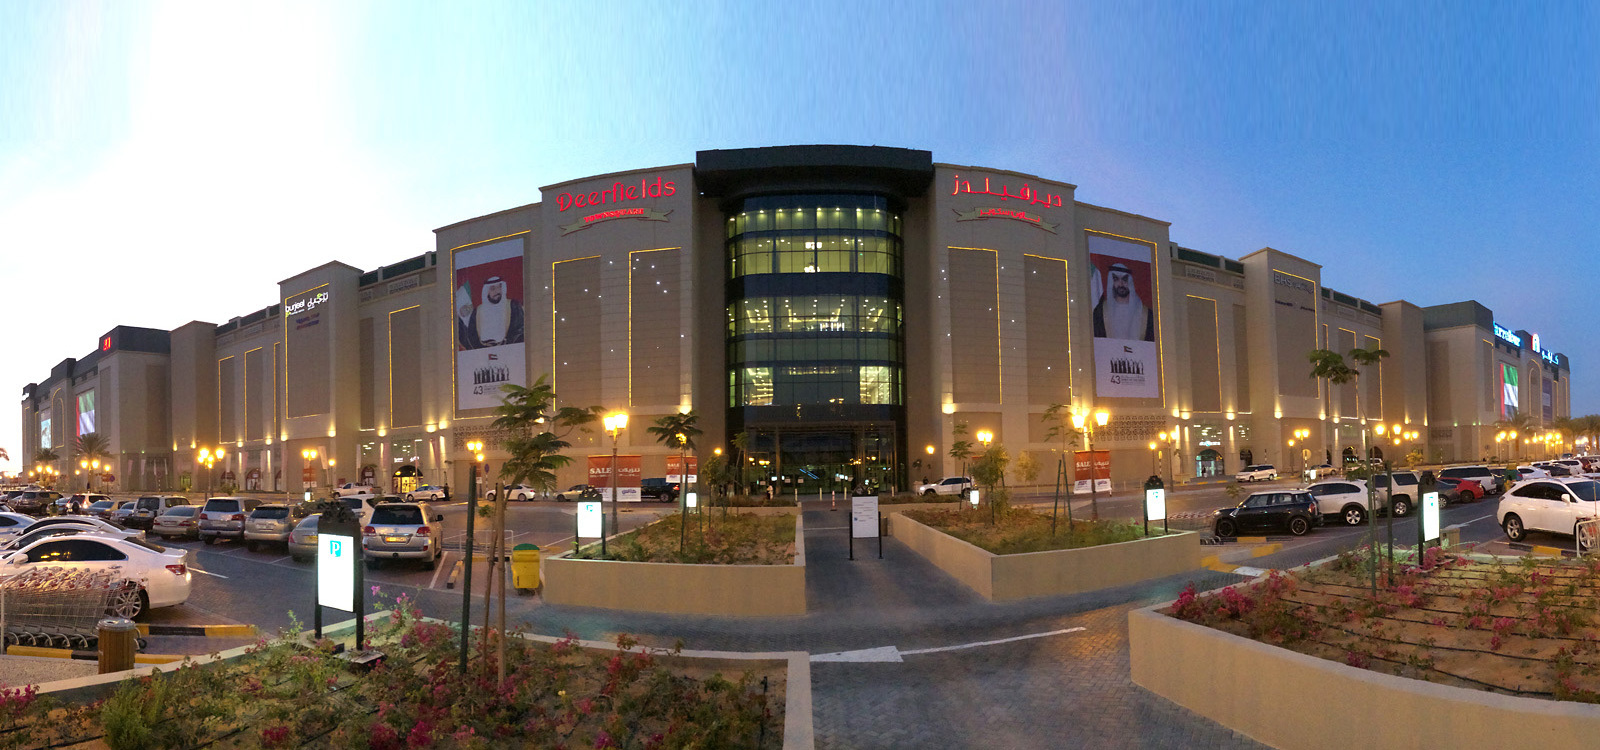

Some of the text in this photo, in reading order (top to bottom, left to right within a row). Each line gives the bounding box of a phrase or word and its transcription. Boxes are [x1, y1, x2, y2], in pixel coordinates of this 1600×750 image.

[556, 176, 676, 212] Deerfields
[951, 175, 1062, 208] ديرفيلدز
[1110, 375, 1121, 385] 43
[473, 385, 483, 395] 43
[589, 467, 612, 475] SALE
